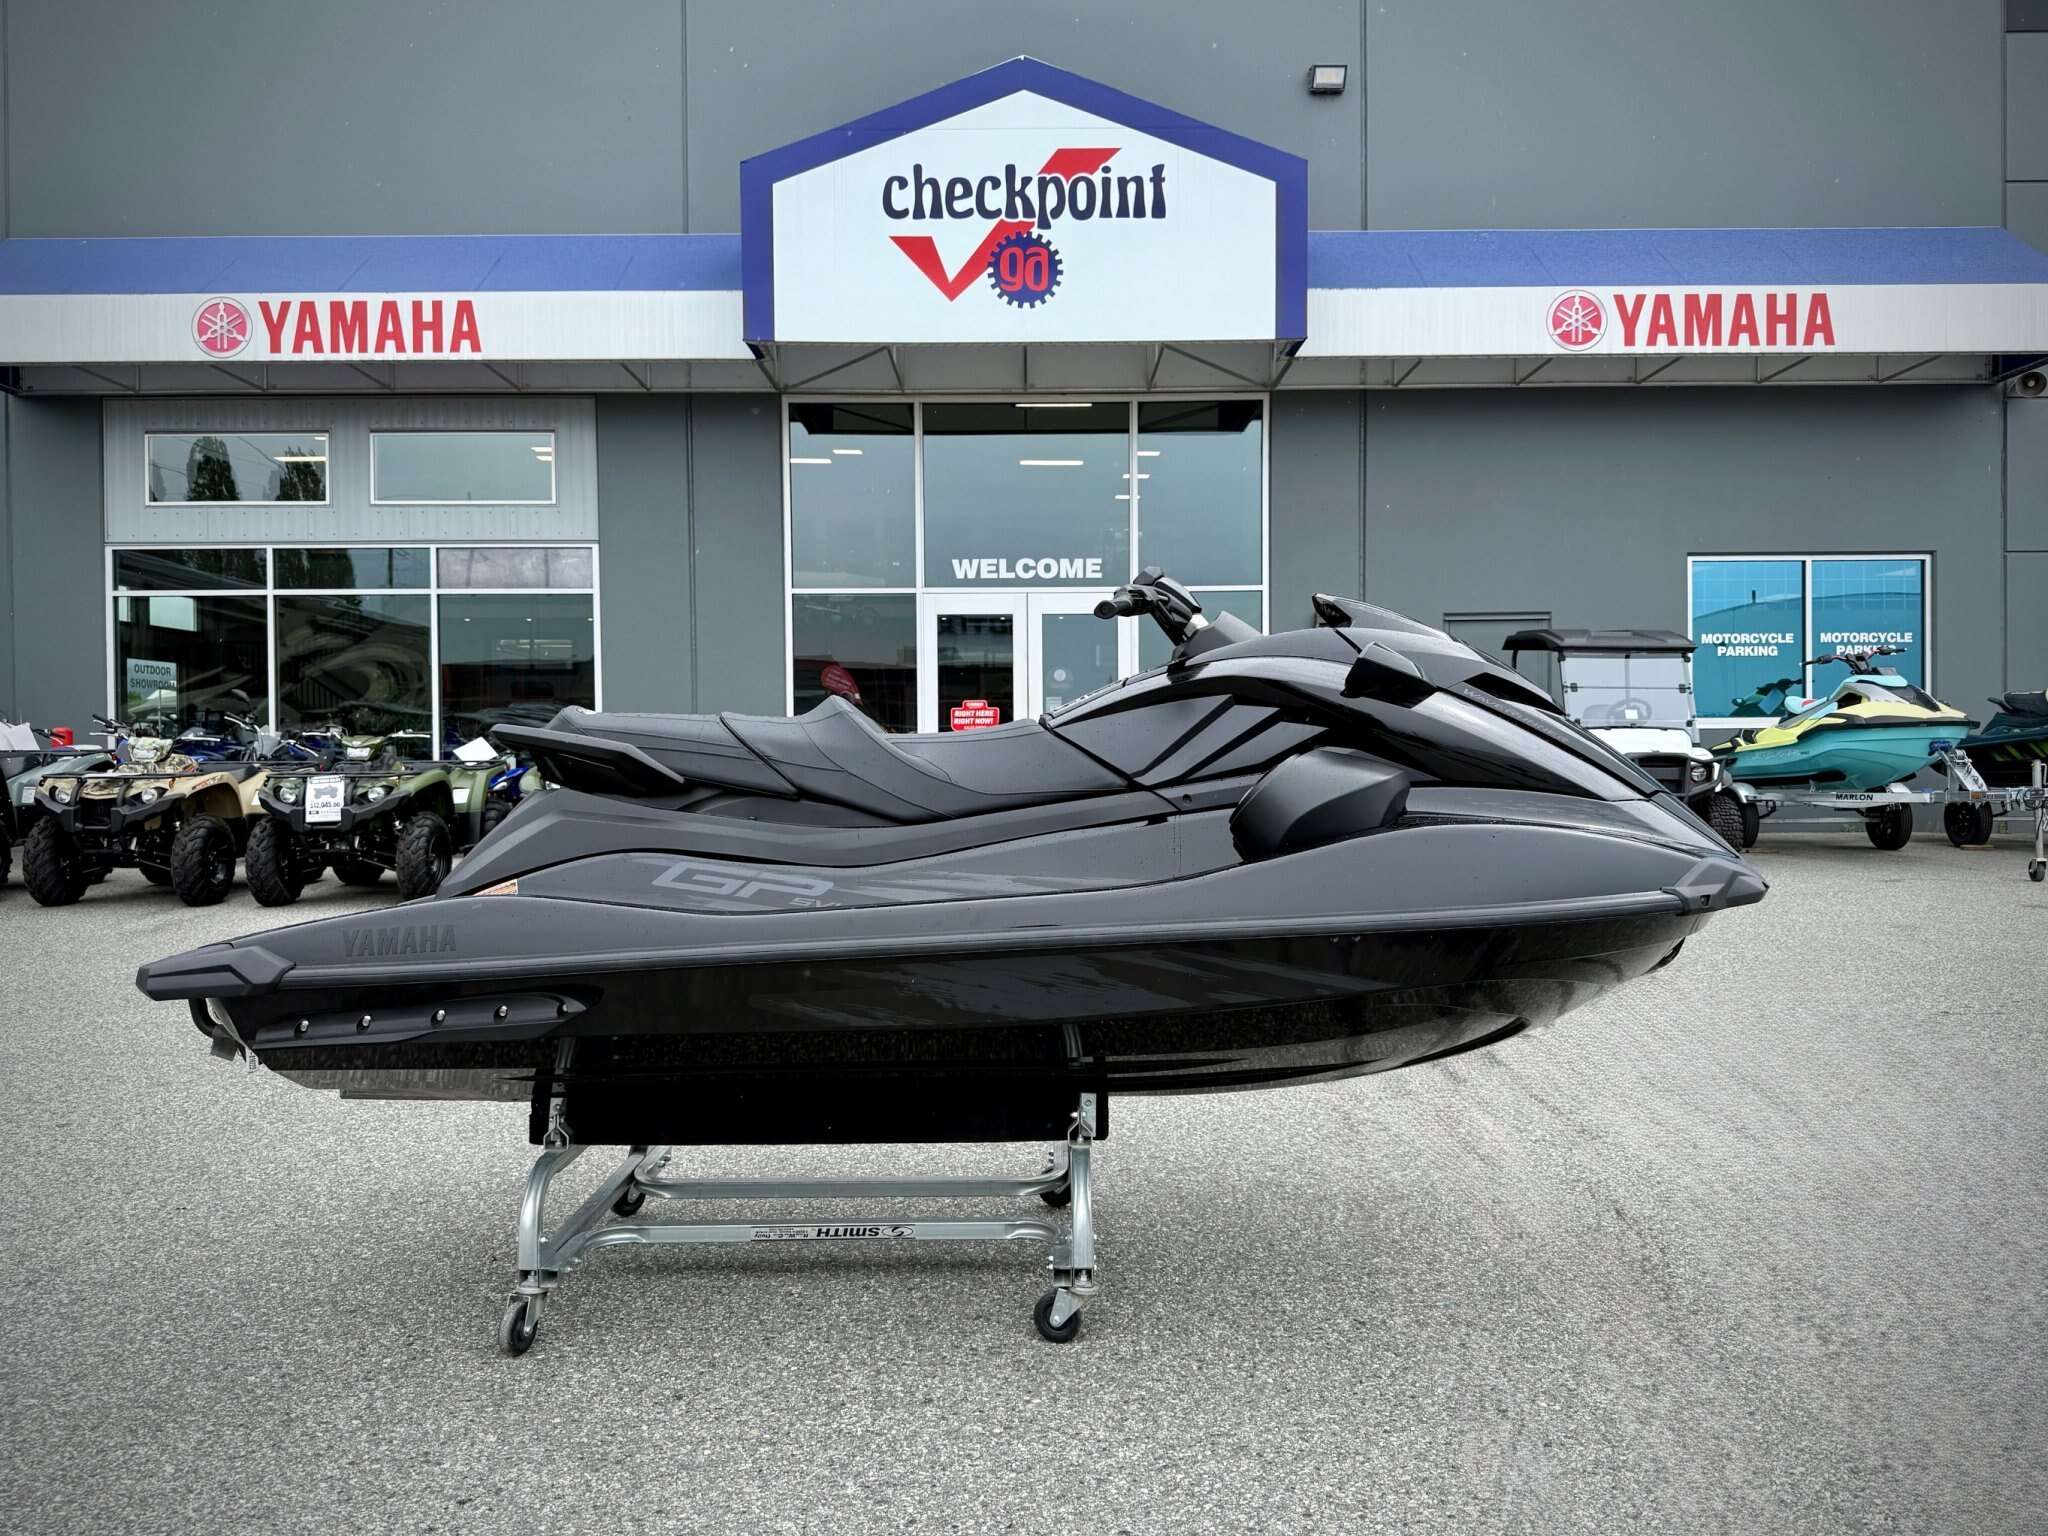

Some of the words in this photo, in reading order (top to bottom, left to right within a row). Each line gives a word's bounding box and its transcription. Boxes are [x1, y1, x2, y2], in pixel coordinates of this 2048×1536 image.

[882, 163, 1166, 230] checkpoint
[258, 300, 482, 354] YAMAHA
[1613, 293, 1836, 347] YAMAHA
[951, 557, 1103, 579] WELCOME
[1701, 633, 1794, 644] MOTORCYCLE
[1820, 632, 1913, 643] MOTORCYCLE
[1717, 645, 1778, 656] PARKING
[1836, 644, 1897, 655] PARK
[134, 663, 171, 676] OUTDOOR
[652, 861, 835, 899] GP
[342, 924, 457, 957] YAMAHA
